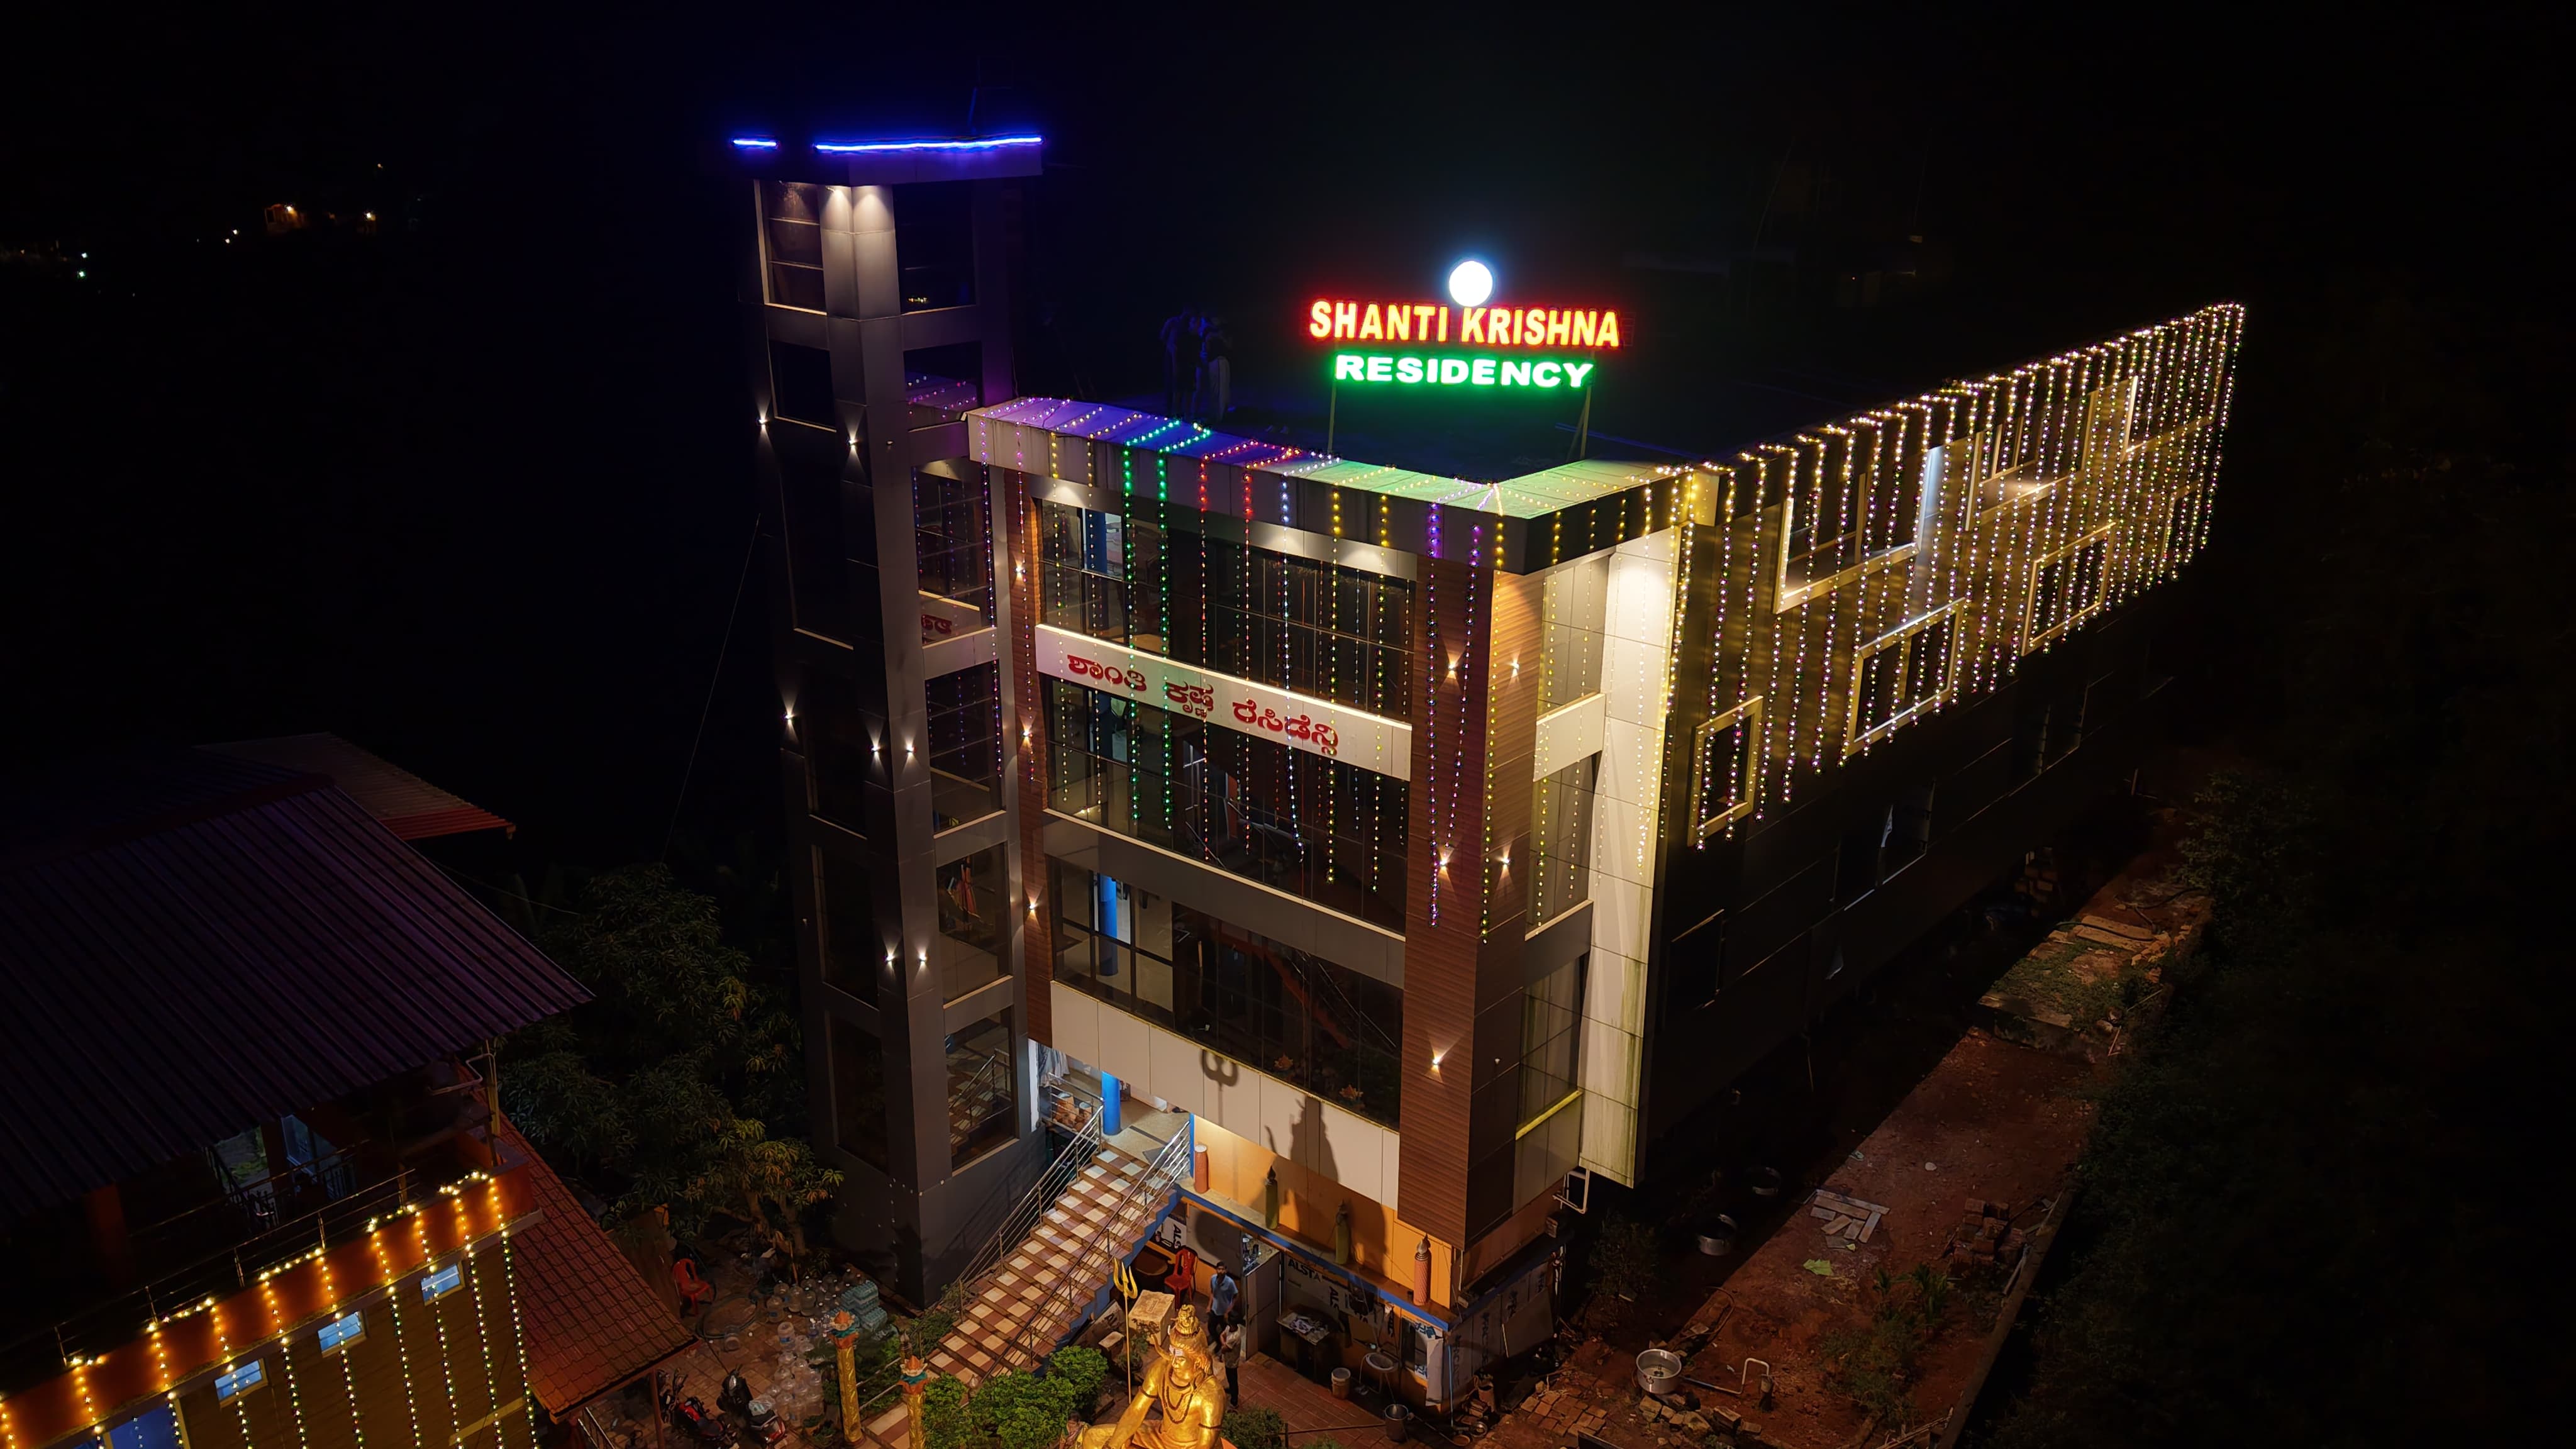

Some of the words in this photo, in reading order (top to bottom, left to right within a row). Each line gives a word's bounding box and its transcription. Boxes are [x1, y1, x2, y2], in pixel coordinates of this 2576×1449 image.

[1309, 299, 1448, 343] SHANTI
[1461, 307, 1619, 348] KRISHNA
[1335, 355, 1594, 388] RESIDENCY
[1067, 654, 1147, 692] ಶಾಂತಿ
